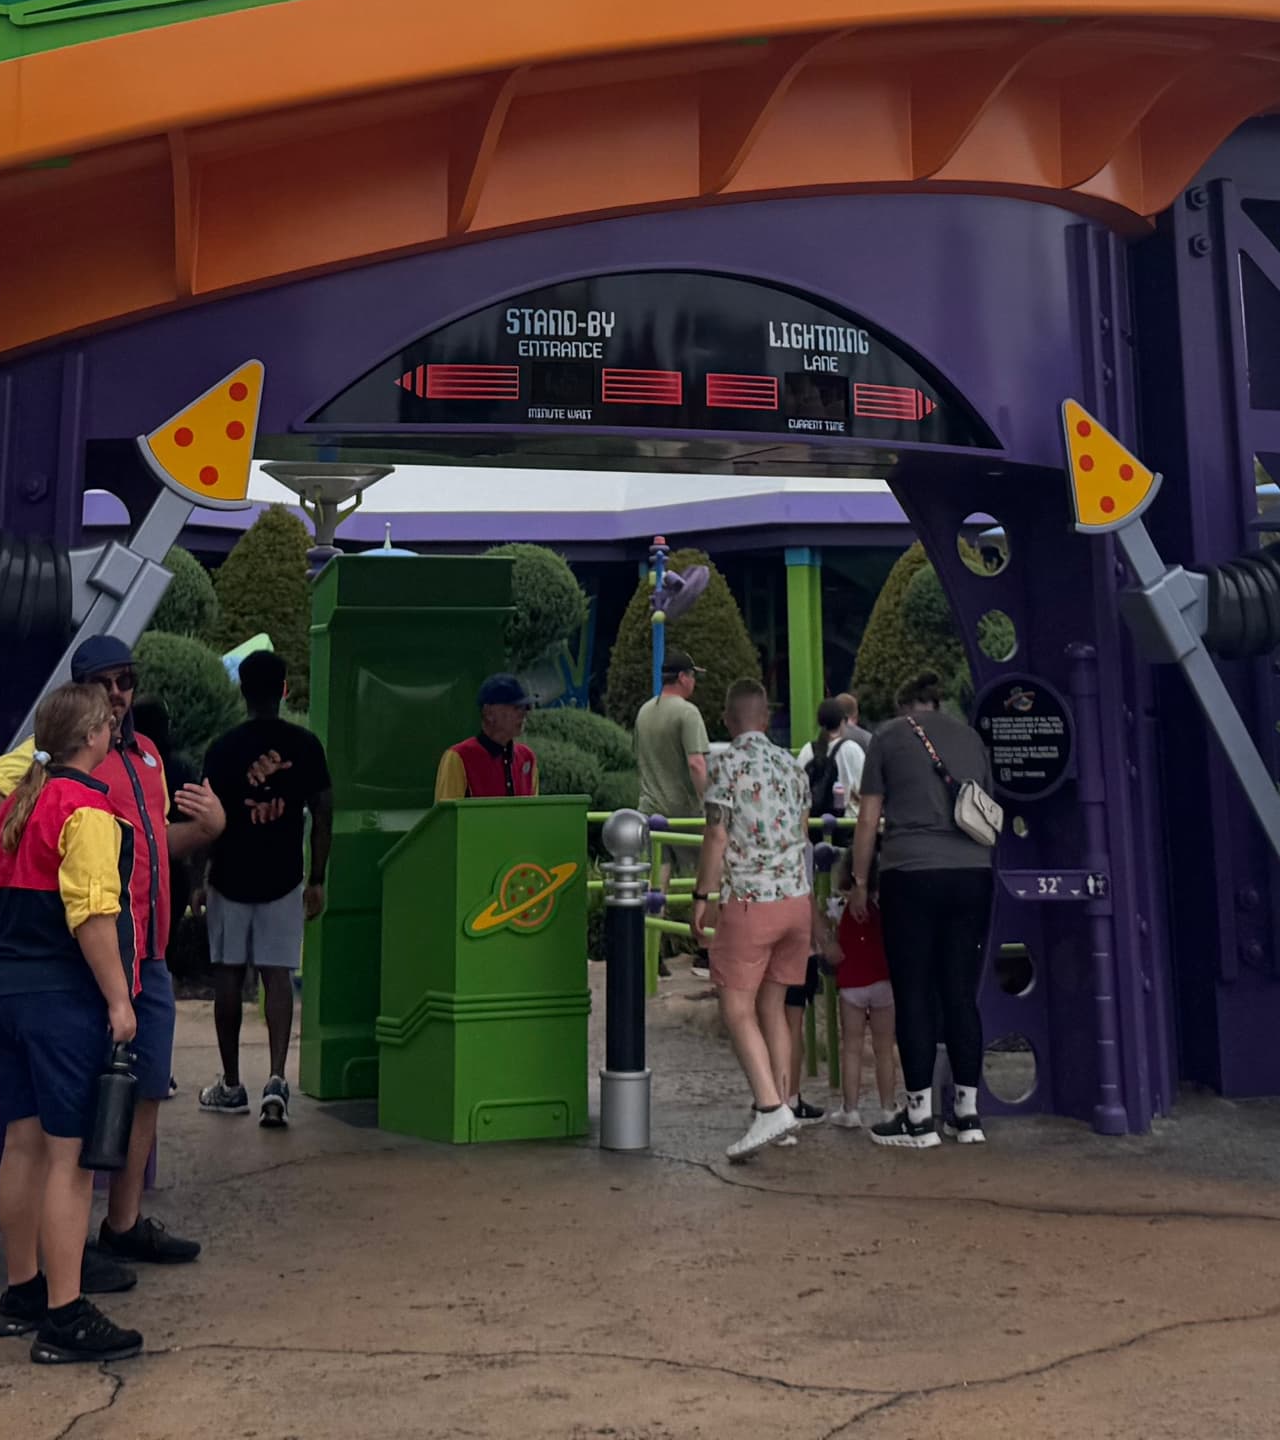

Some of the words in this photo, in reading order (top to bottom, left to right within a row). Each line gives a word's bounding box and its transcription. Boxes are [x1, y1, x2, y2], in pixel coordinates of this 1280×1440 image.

[506, 308, 615, 337] STAND-BY
[769, 321, 869, 355] LIGHTNING
[518, 340, 603, 359] ENTRANCE
[803, 355, 839, 372] LANE
[527, 408, 565, 419] MINUTE
[567, 409, 592, 420] WAIT
[788, 418, 823, 430] CURRENT
[824, 420, 845, 432] TIME
